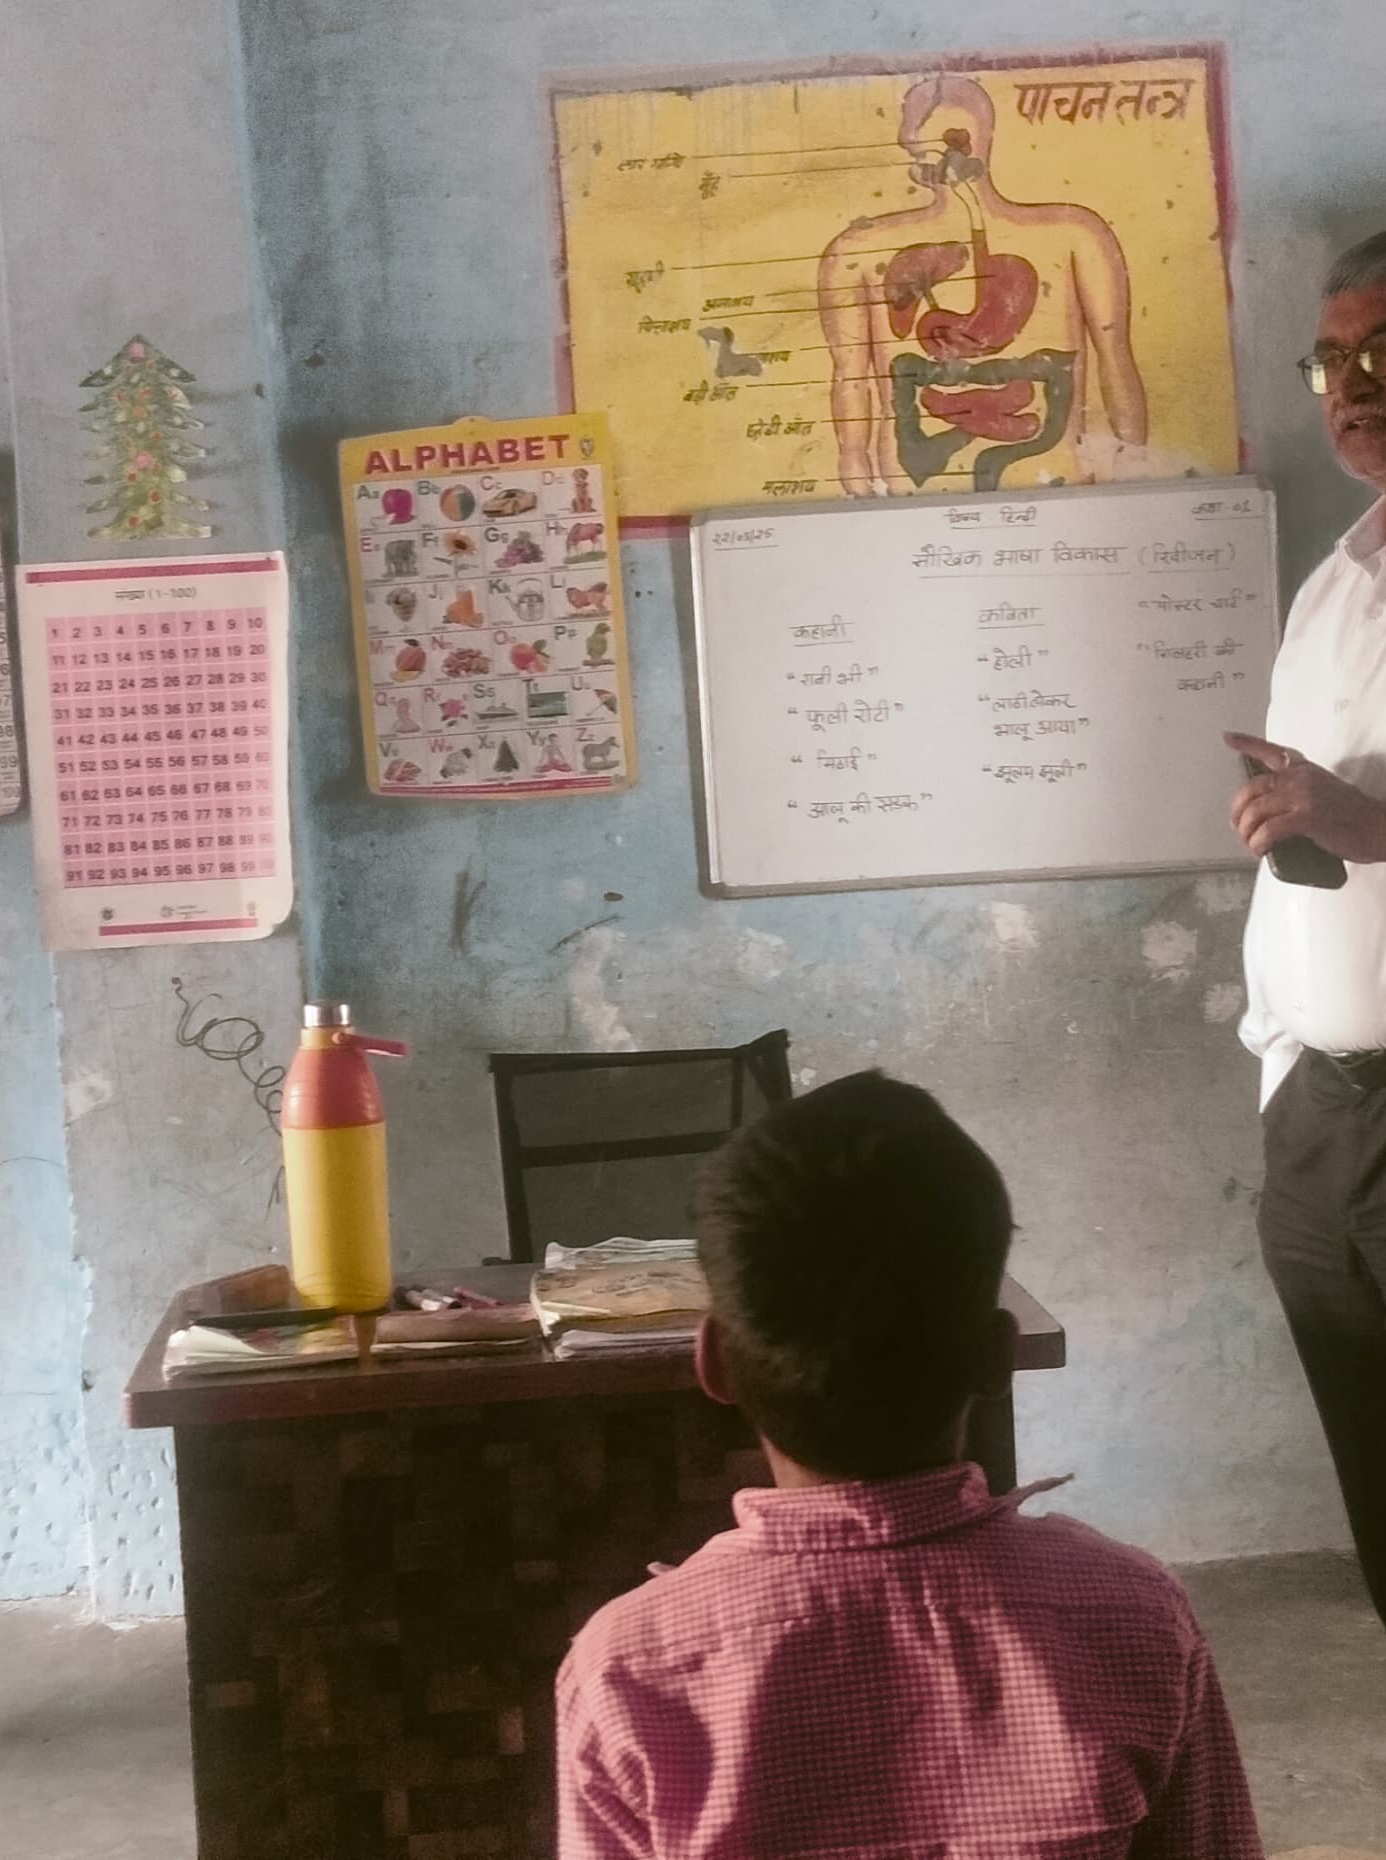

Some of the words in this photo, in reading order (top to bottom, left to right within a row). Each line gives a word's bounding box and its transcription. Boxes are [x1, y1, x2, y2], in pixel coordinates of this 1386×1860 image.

[1013, 80, 1113, 126] पाचन
[364, 434, 570, 475] ALPHABET
[1051, 540, 1128, 564] विकास
[246, 616, 264, 629] 10
[51, 654, 66, 666] 11
[71, 653, 88, 666] 12
[93, 652, 110, 664] 13
[116, 651, 133, 663] 14
[138, 649, 155, 661] 15
[182, 647, 200, 659] 17
[52, 681, 69, 694] 21
[74, 681, 91, 693] 22
[118, 677, 136, 690] 24
[140, 676, 158, 689] 25
[163, 675, 181, 688] 26
[185, 673, 203, 687] 27
[75, 707, 93, 720] 32
[141, 703, 159, 716] 35
[164, 703, 182, 716] 36
[186, 701, 204, 715] 37
[56, 735, 72, 746] 41
[77, 733, 95, 746] 42
[121, 732, 139, 743] 44
[189, 728, 207, 741] 47
[57, 761, 75, 774] 51
[79, 760, 97, 773] 52
[123, 758, 142, 770] 54
[145, 756, 164, 769] 55
[168, 755, 186, 768] 56
[190, 754, 208, 767] 57
[147, 784, 166, 797] 65
[192, 782, 210, 795] 67
[61, 816, 78, 828] 71
[83, 814, 101, 827] 72
[127, 812, 145, 825] 74
[150, 810, 168, 823] 75
[87, 868, 105, 881] 92
[131, 867, 148, 879] 94
[197, 862, 214, 875] 97
